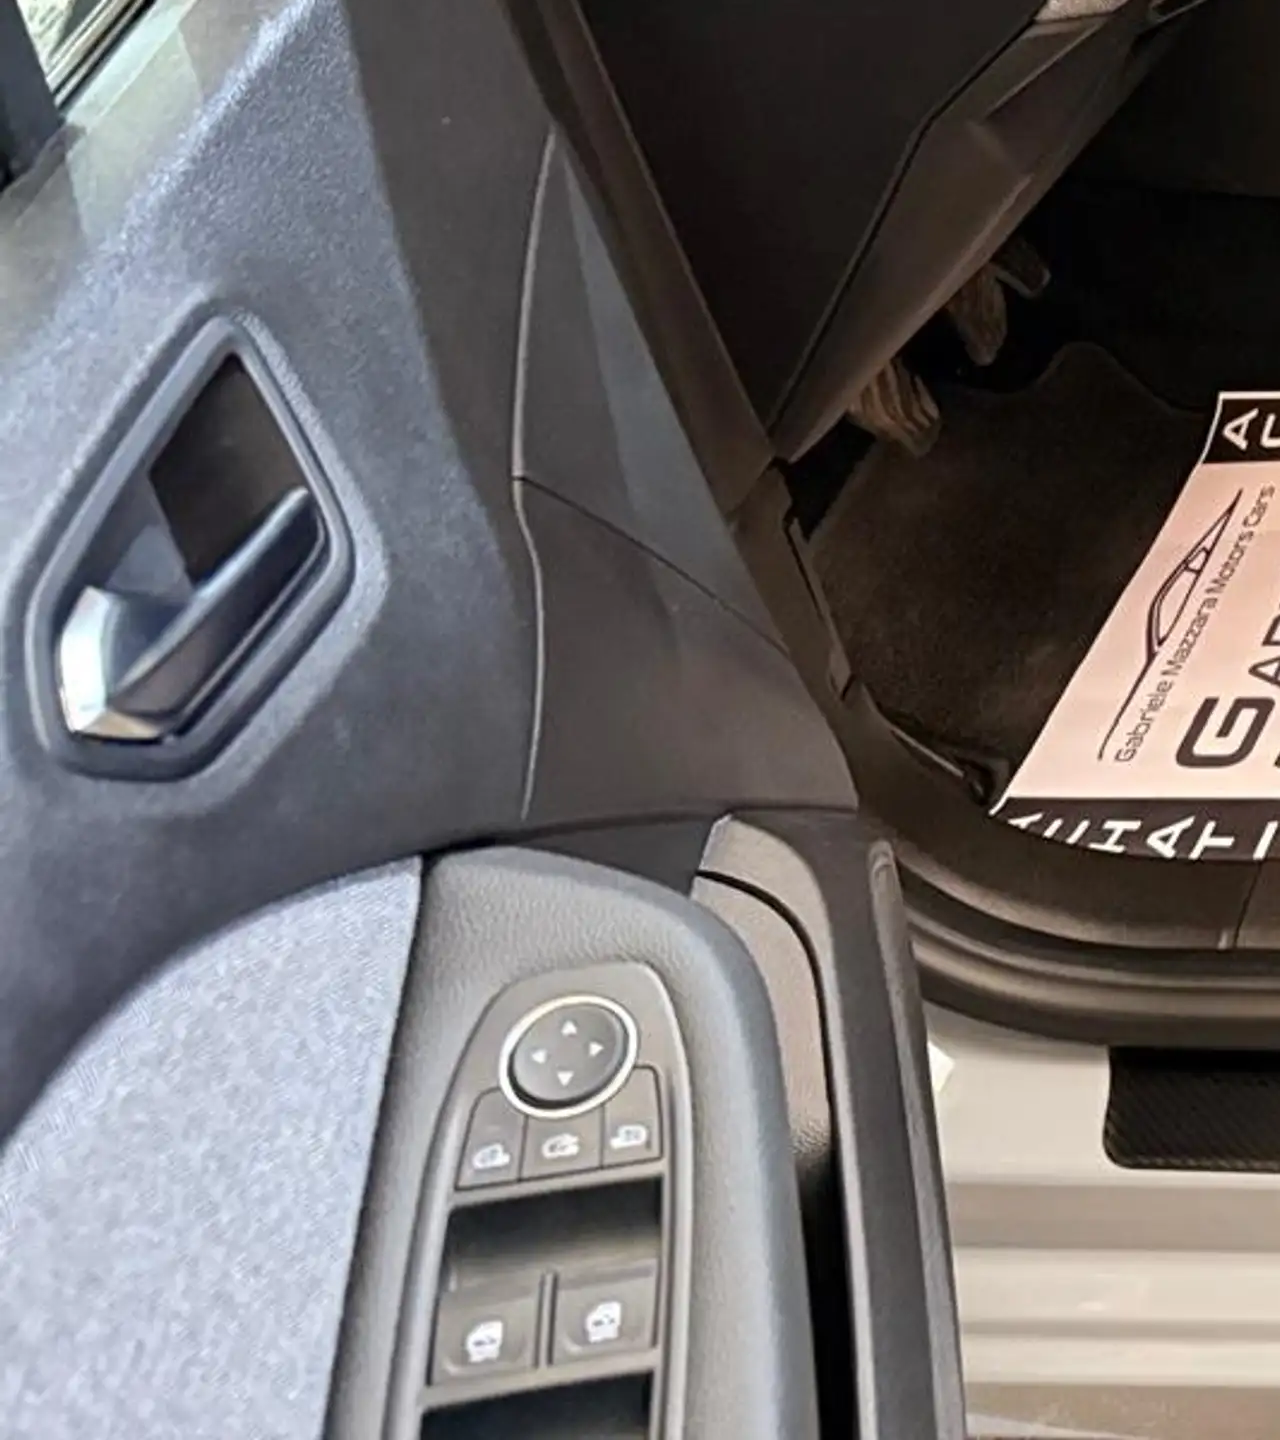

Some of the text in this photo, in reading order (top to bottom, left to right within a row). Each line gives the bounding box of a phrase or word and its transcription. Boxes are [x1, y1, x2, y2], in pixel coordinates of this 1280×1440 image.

[1114, 677, 1174, 762] Gabriele
[1161, 595, 1219, 677] Mazzara
[1205, 529, 1254, 594] Motors
